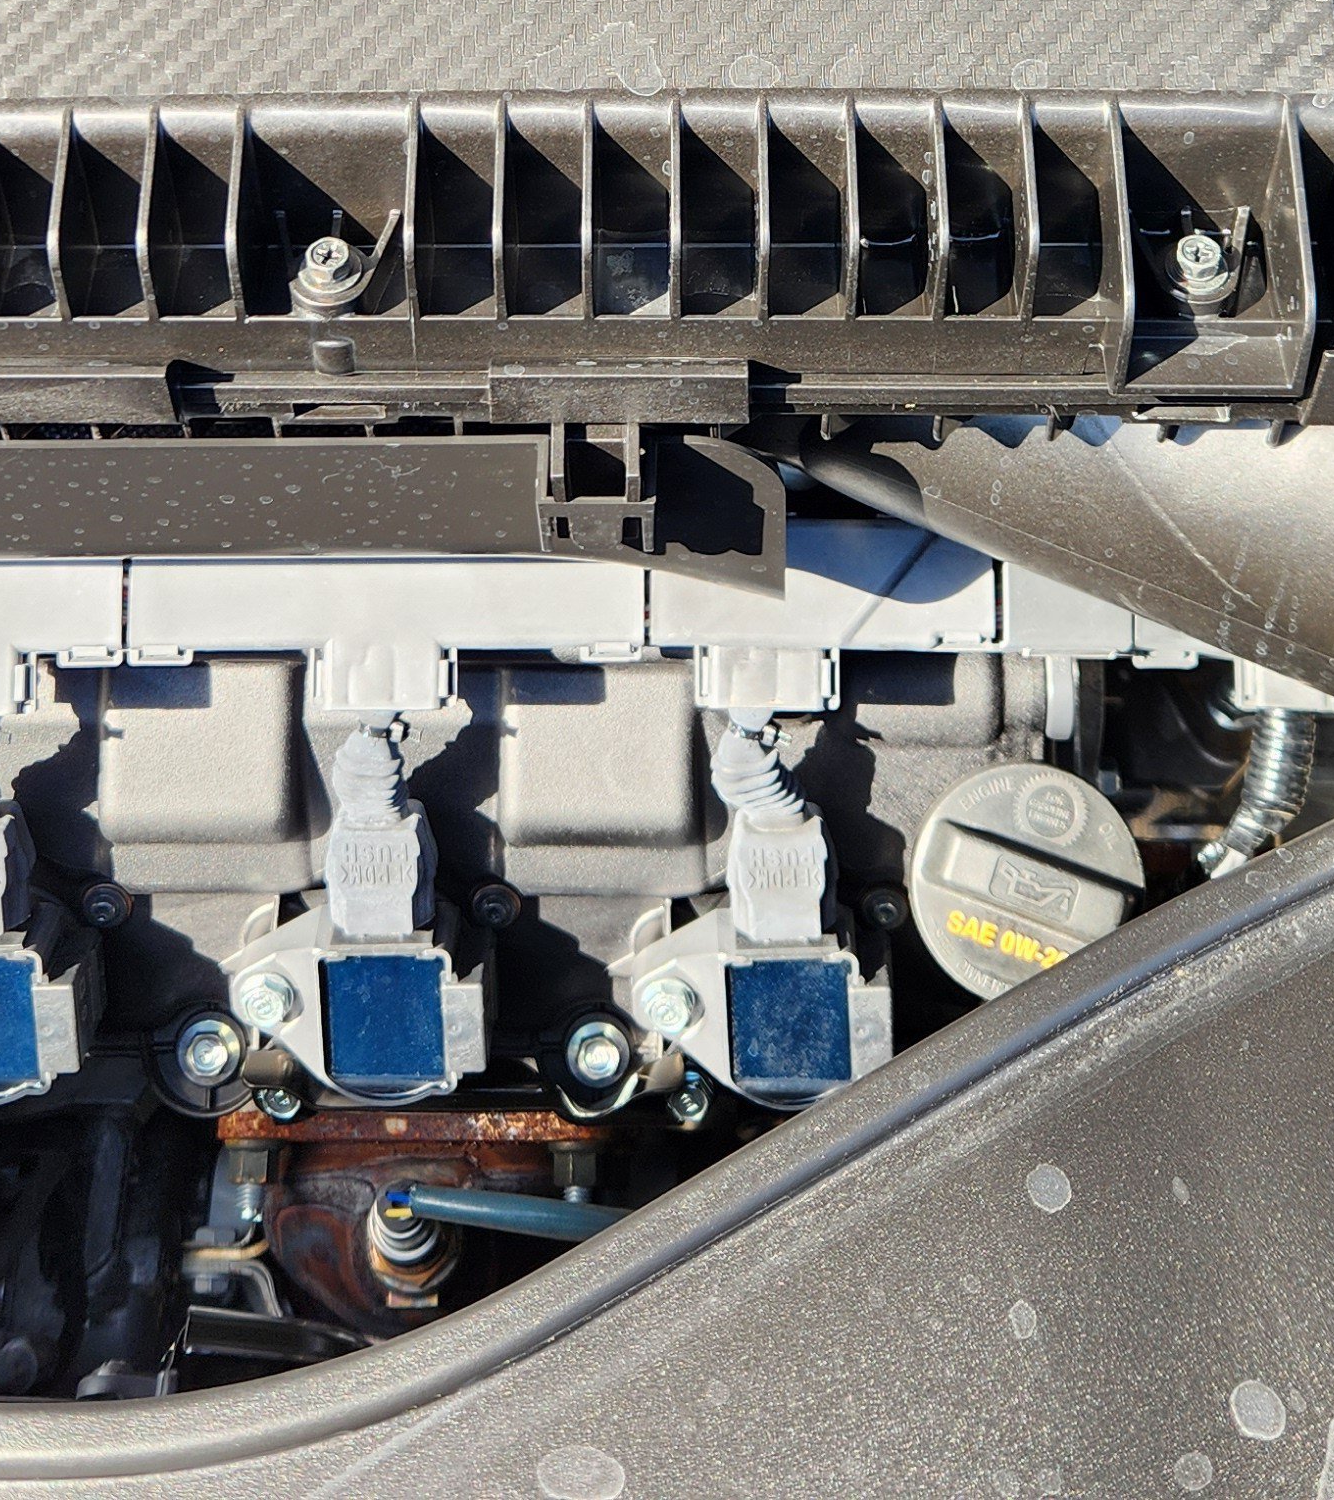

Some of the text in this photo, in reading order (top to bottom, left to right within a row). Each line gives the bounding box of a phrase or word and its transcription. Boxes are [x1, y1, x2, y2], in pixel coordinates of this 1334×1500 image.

[345, 842, 409, 863] PUSH
[751, 846, 817, 868] PUSH
[946, 909, 999, 949] SAE
